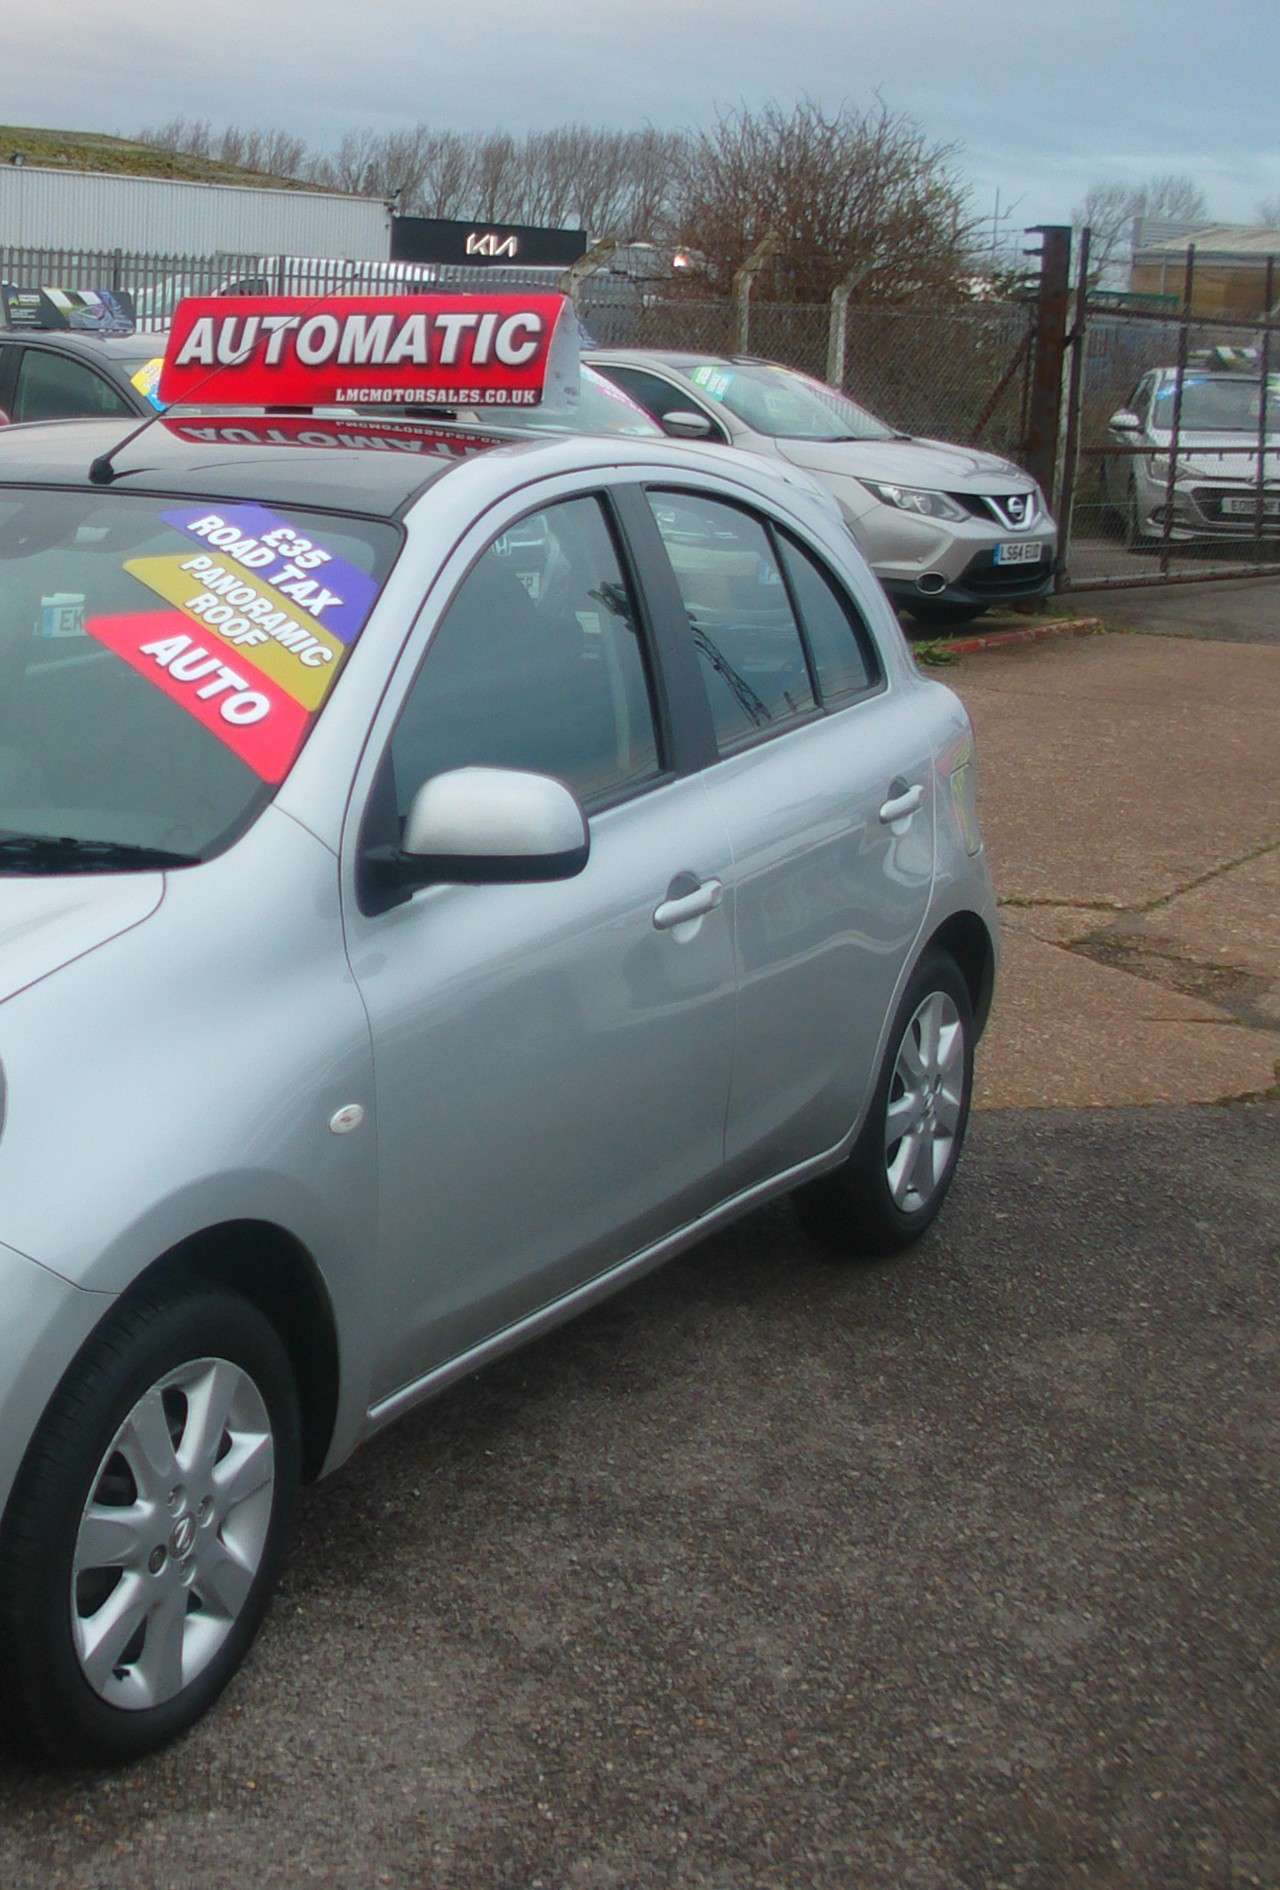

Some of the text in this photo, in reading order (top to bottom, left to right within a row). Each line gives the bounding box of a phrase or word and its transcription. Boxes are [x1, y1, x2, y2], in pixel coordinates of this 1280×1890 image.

[466, 232, 518, 258] KIA
[175, 312, 542, 366] AUTOMATIC
[335, 388, 536, 405] LMCMOTORSALES.CO.UK
[187, 514, 344, 617] ROAD TAX
[261, 527, 333, 569] £35
[180, 555, 334, 668] PANORAMIC
[184, 592, 269, 647] ROOF
[139, 634, 271, 725] AUTO
